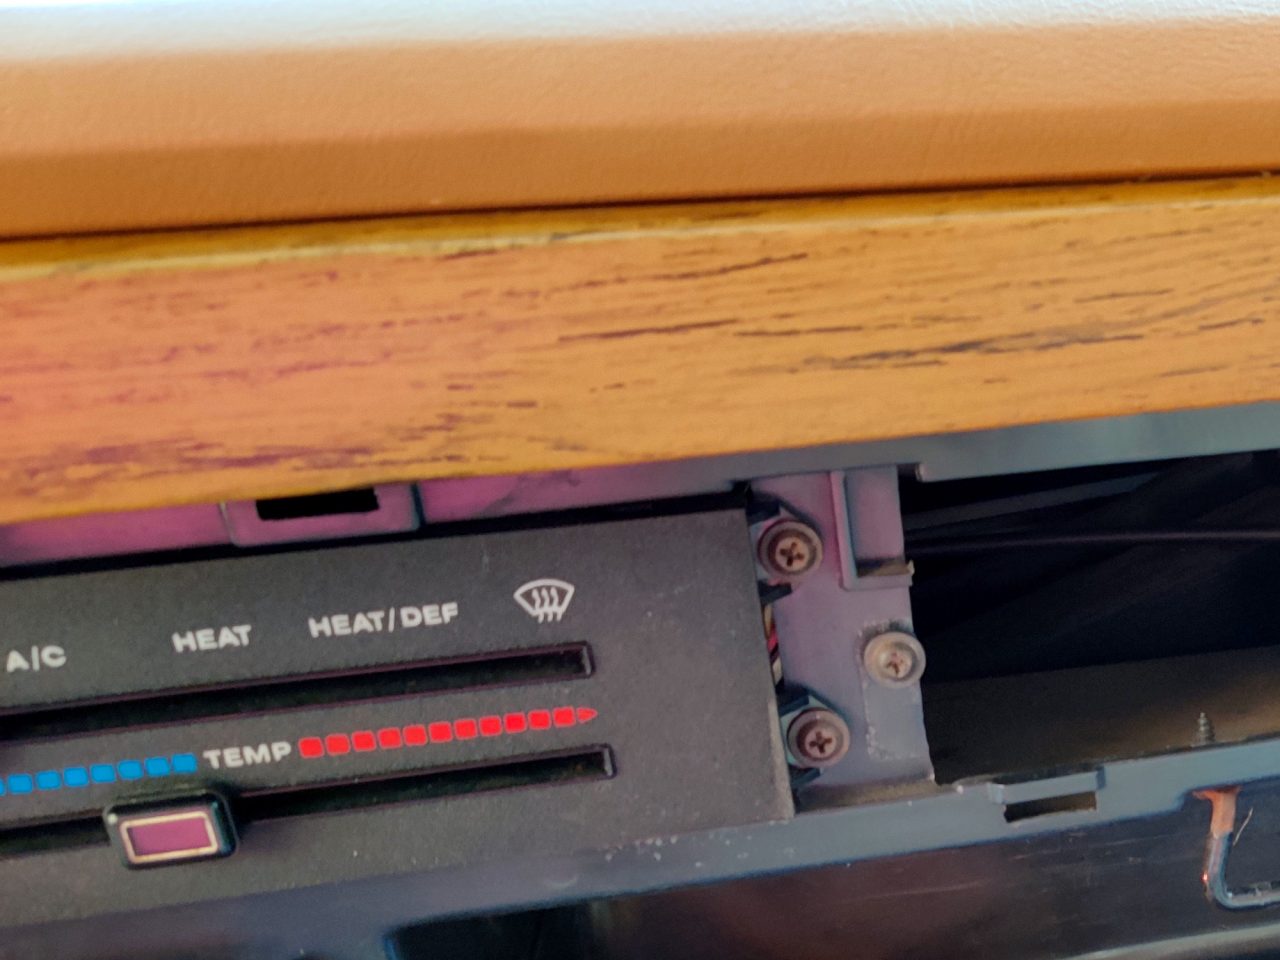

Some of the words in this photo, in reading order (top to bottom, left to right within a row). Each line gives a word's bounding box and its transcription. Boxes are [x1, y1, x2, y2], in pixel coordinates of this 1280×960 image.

[308, 602, 459, 638] HEAT/DEF
[171, 624, 252, 653] HEAT
[6, 645, 67, 673] A/C
[202, 741, 293, 769] TEMP
